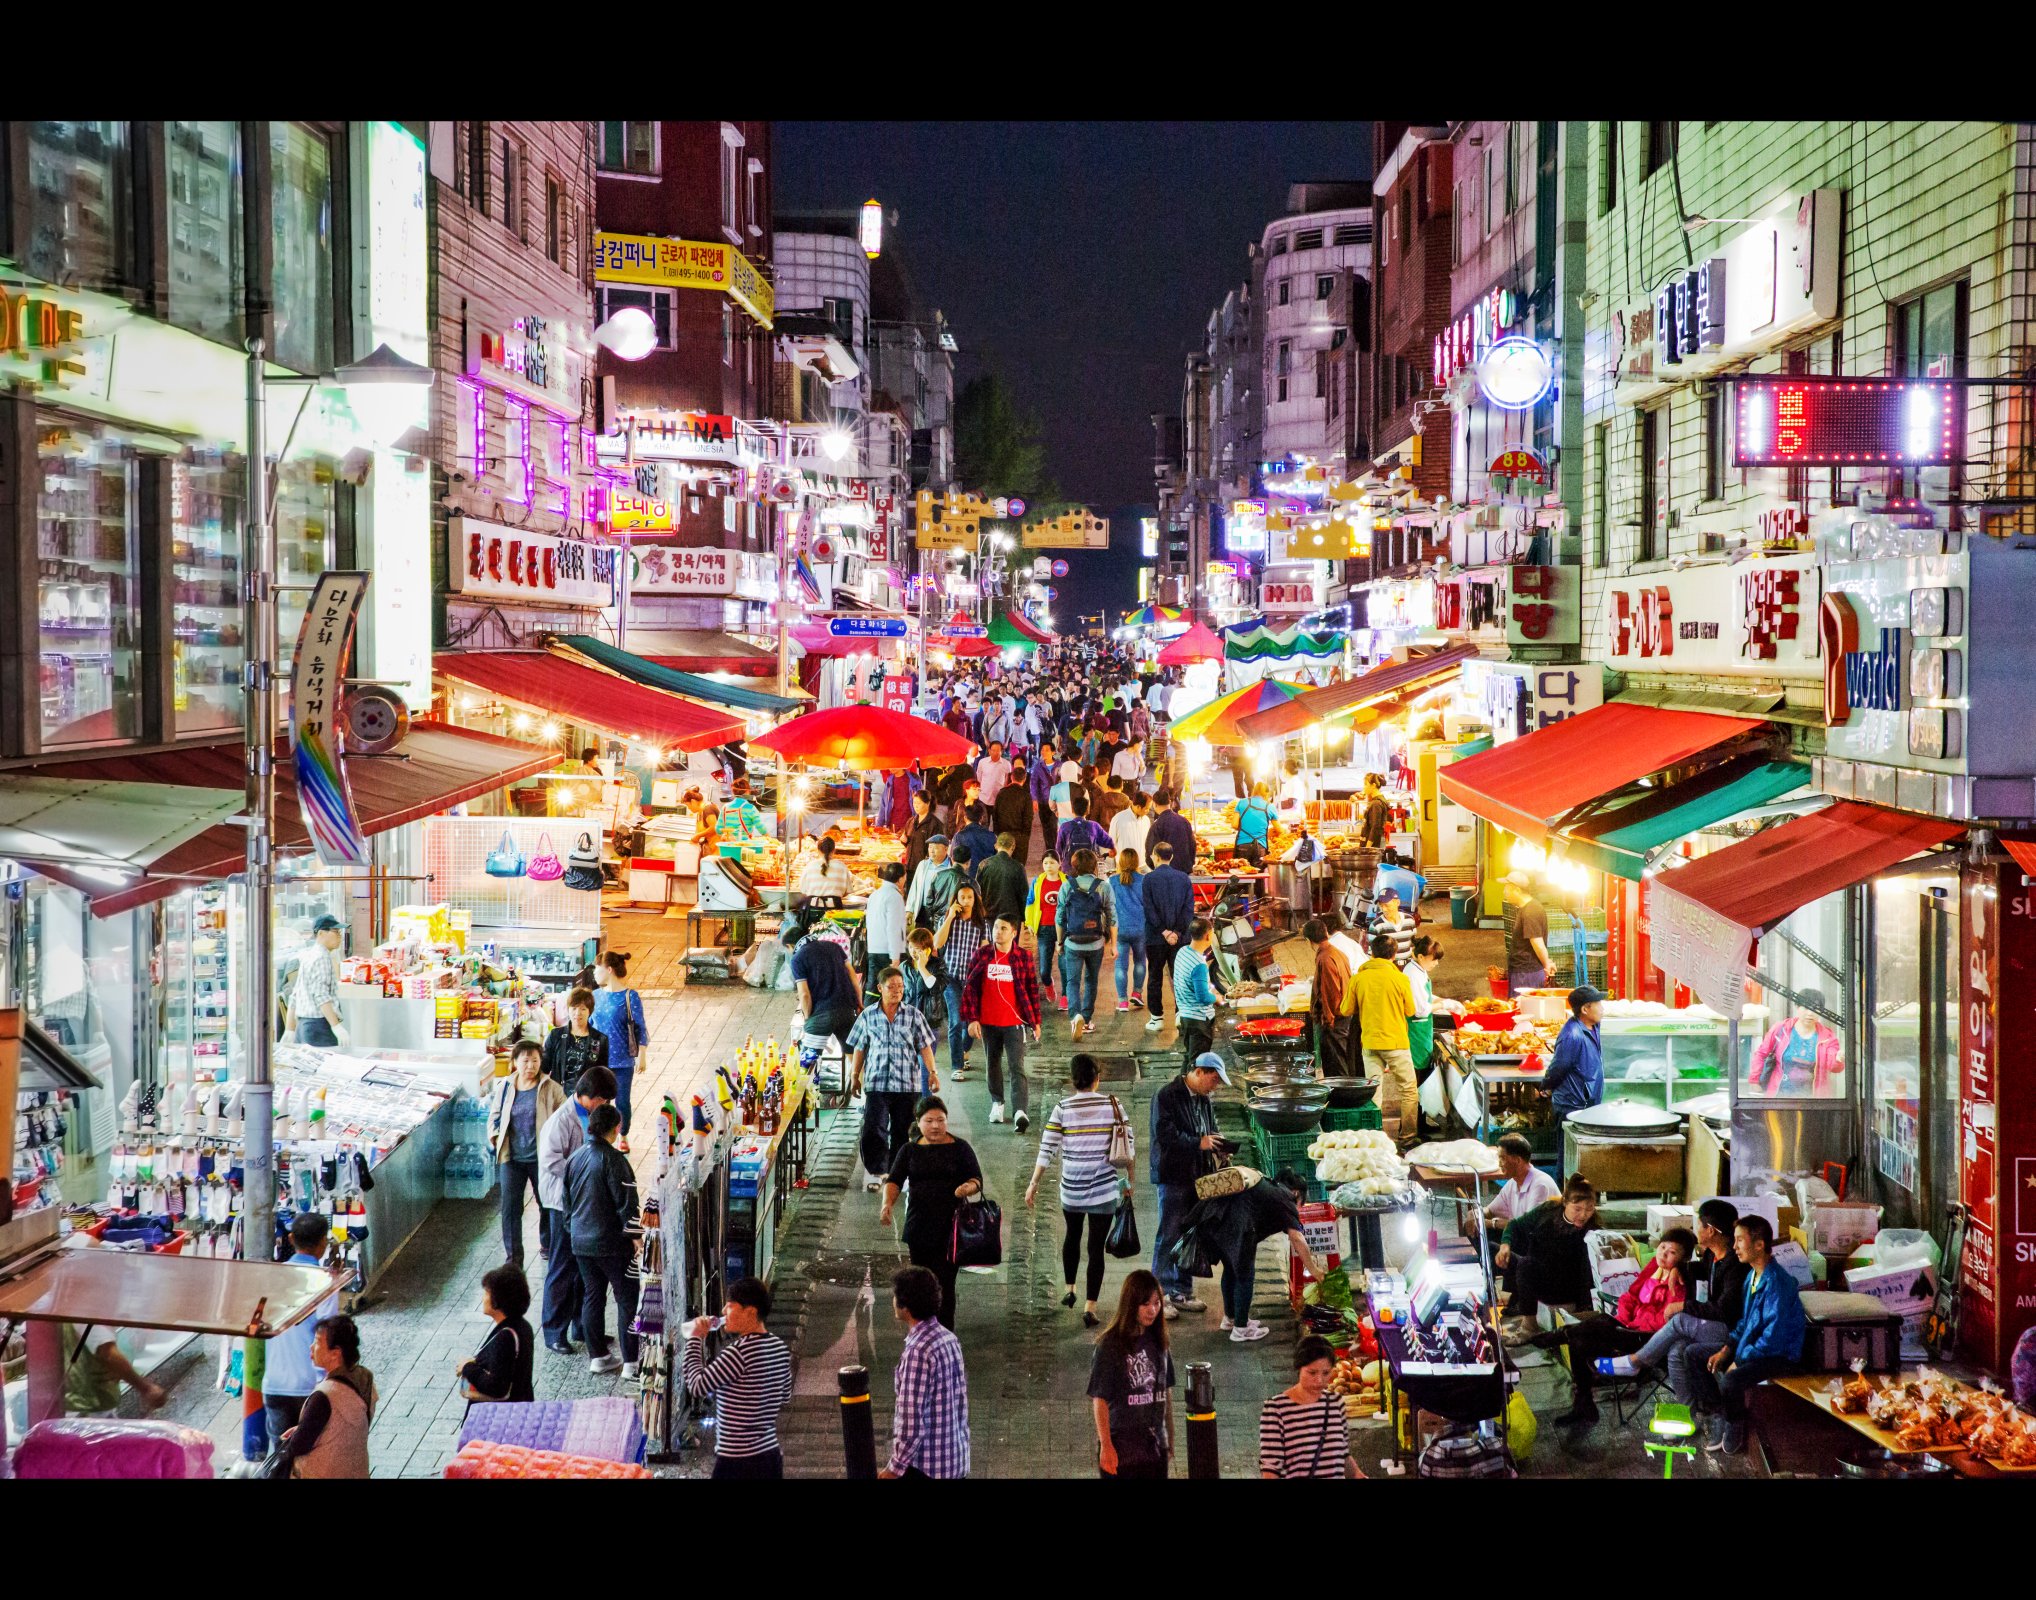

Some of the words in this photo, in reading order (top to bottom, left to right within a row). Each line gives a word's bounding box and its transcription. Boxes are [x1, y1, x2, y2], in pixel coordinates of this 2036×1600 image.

[661, 244, 687, 264] 근로자
[691, 248, 723, 268] 파견업체
[661, 419, 725, 444] HANA
[682, 445, 724, 453] DONESIA
[1503, 453, 1527, 467] 88
[1350, 546, 1370, 556] 中国
[671, 571, 725, 585] 494-7618
[317, 588, 348, 646] 다문화
[305, 655, 327, 738] 음식거리
[1660, 1023, 1688, 1031] GREEN
